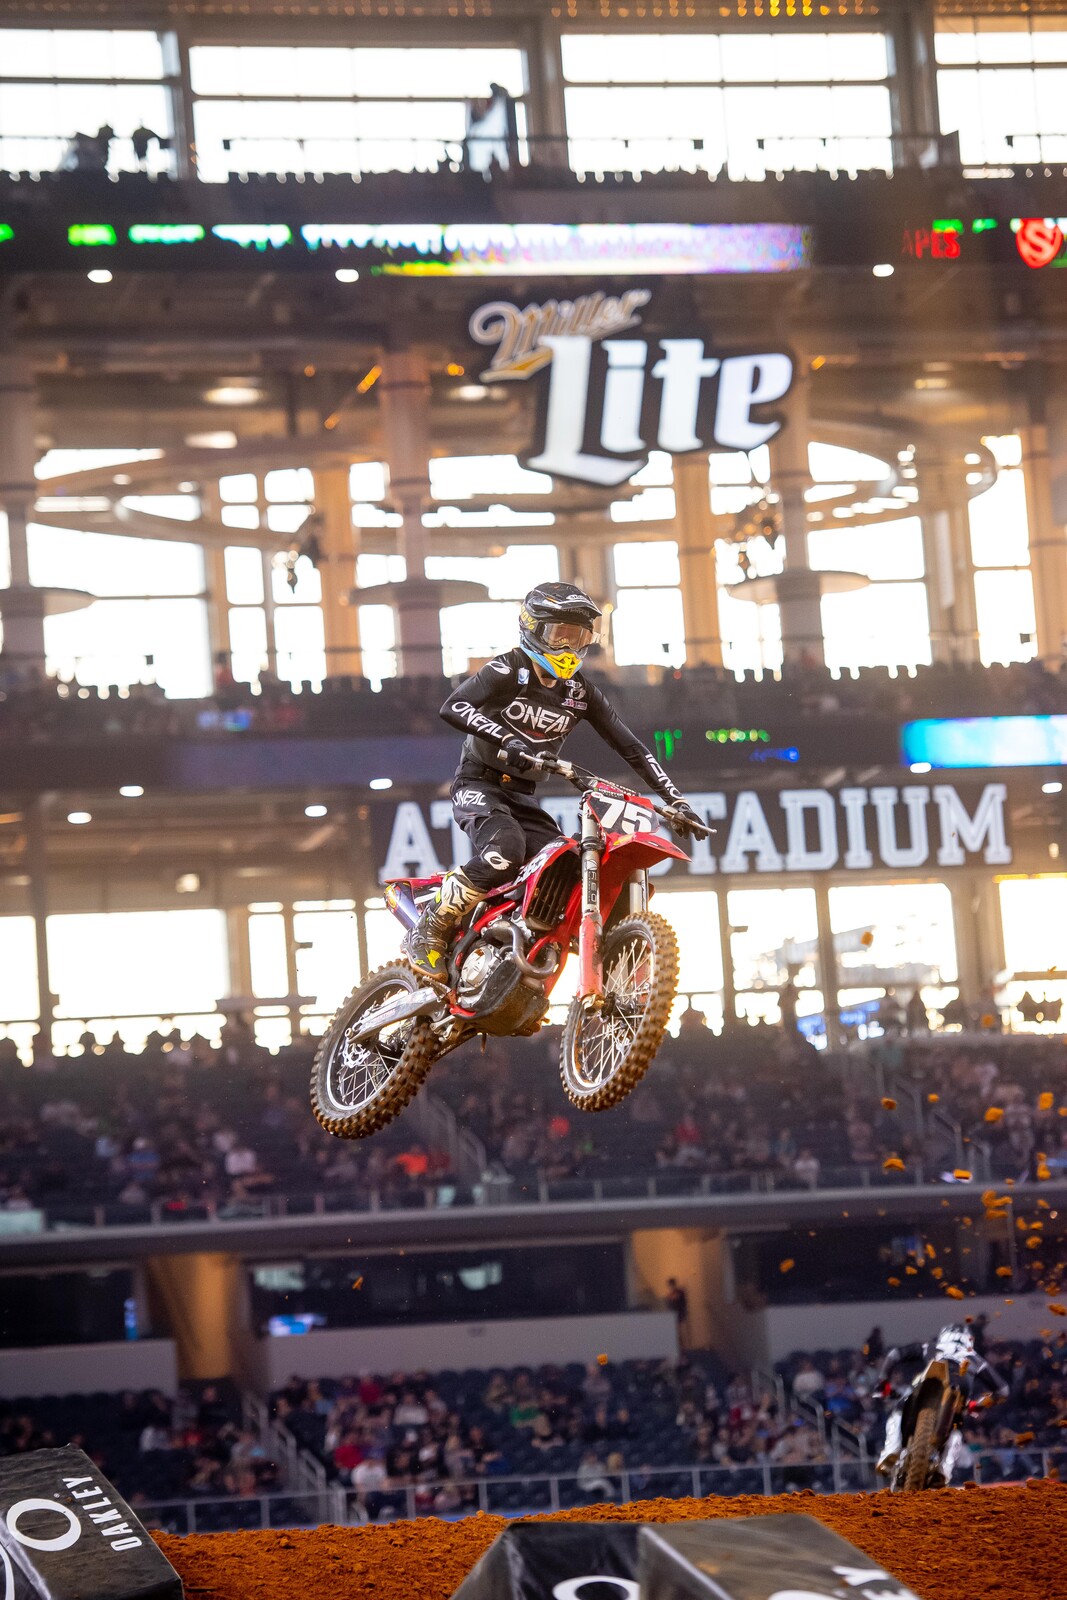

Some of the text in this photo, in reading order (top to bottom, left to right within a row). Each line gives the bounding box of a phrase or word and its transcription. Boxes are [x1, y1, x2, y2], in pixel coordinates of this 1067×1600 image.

[527, 335, 793, 486] Lite
[599, 797, 653, 834] 75
[651, 784, 1012, 877] TADIUM
[62, 1476, 142, 1551] OAKLEY
